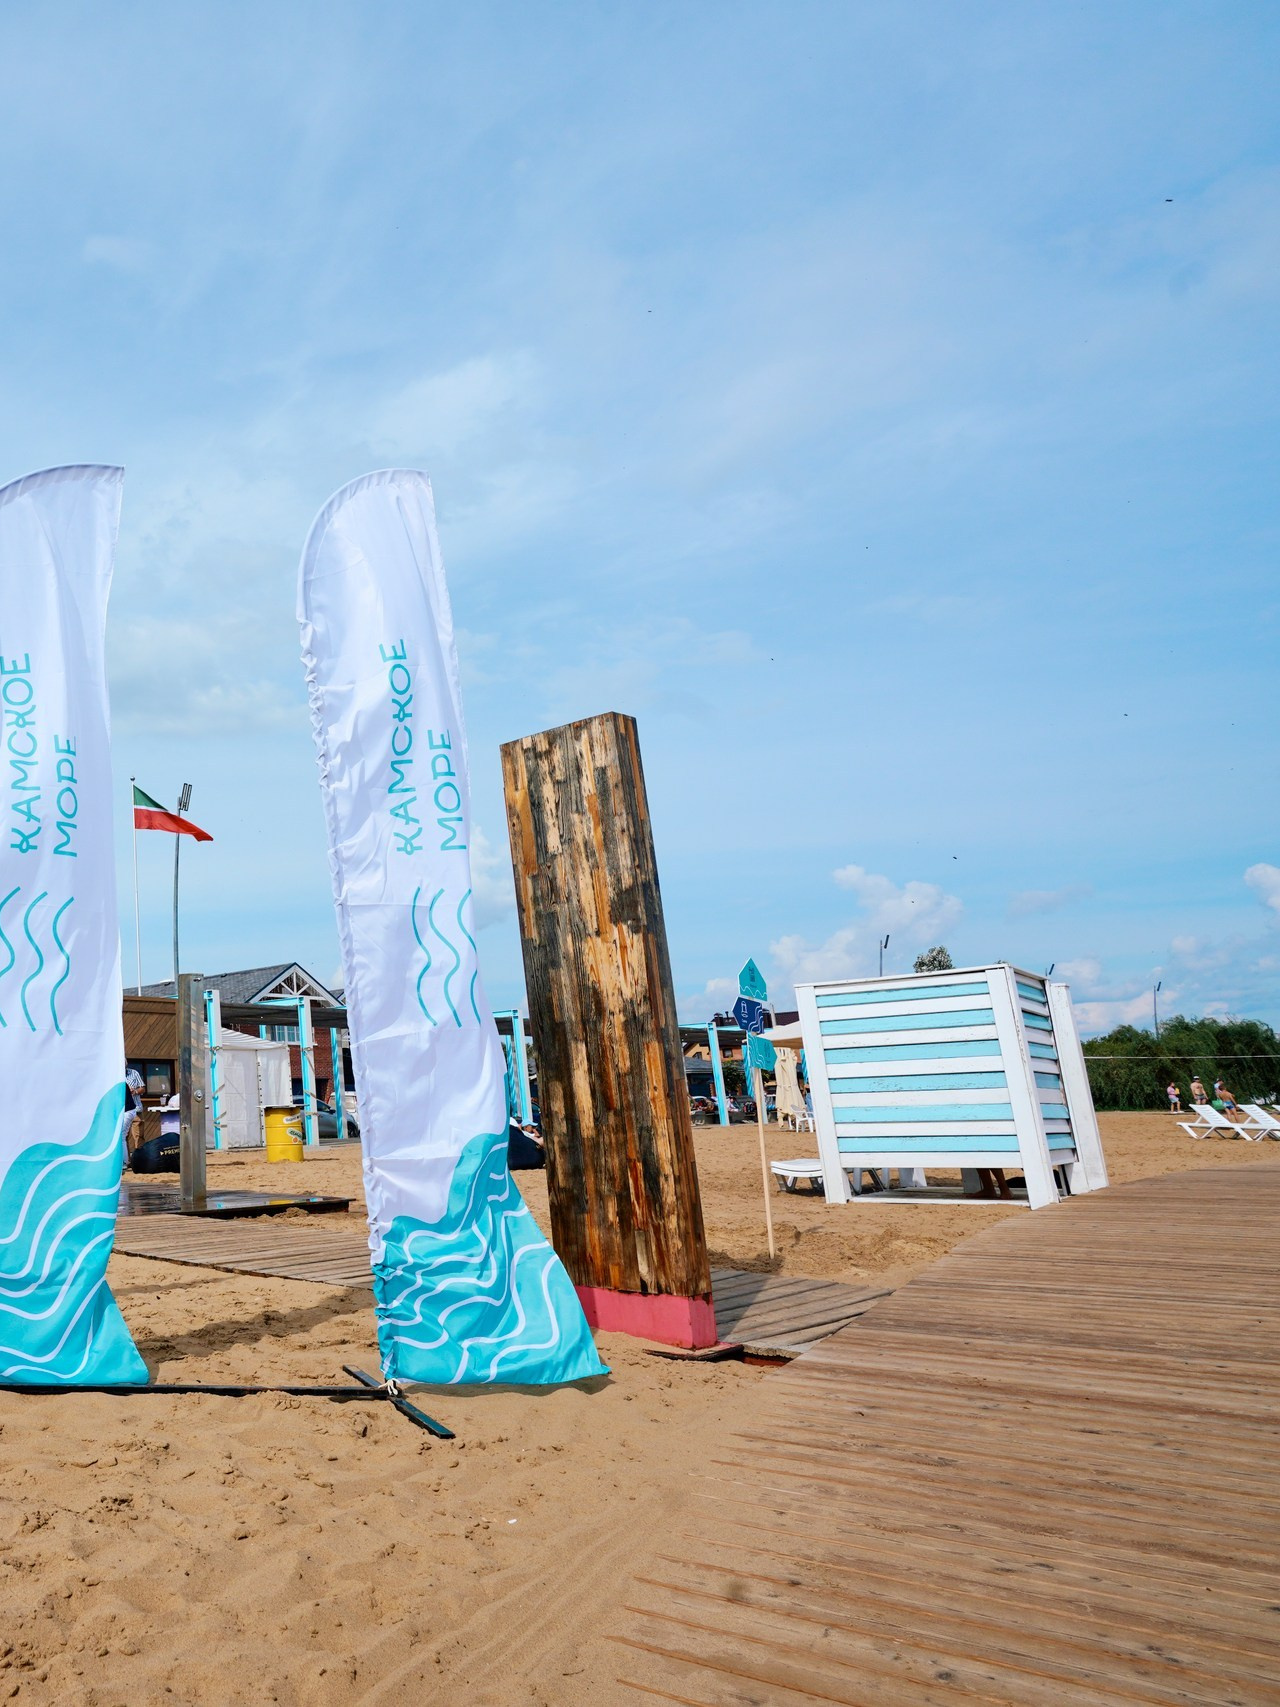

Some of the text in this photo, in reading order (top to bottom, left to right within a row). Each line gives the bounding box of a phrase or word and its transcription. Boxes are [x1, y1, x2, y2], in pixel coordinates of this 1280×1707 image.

[0, 653, 42, 854] КАМСКОЕ
[53, 734, 78, 858] МОРЕ
[378, 638, 423, 856] КАМСКОЕ
[427, 728, 467, 851] МОРЕ
